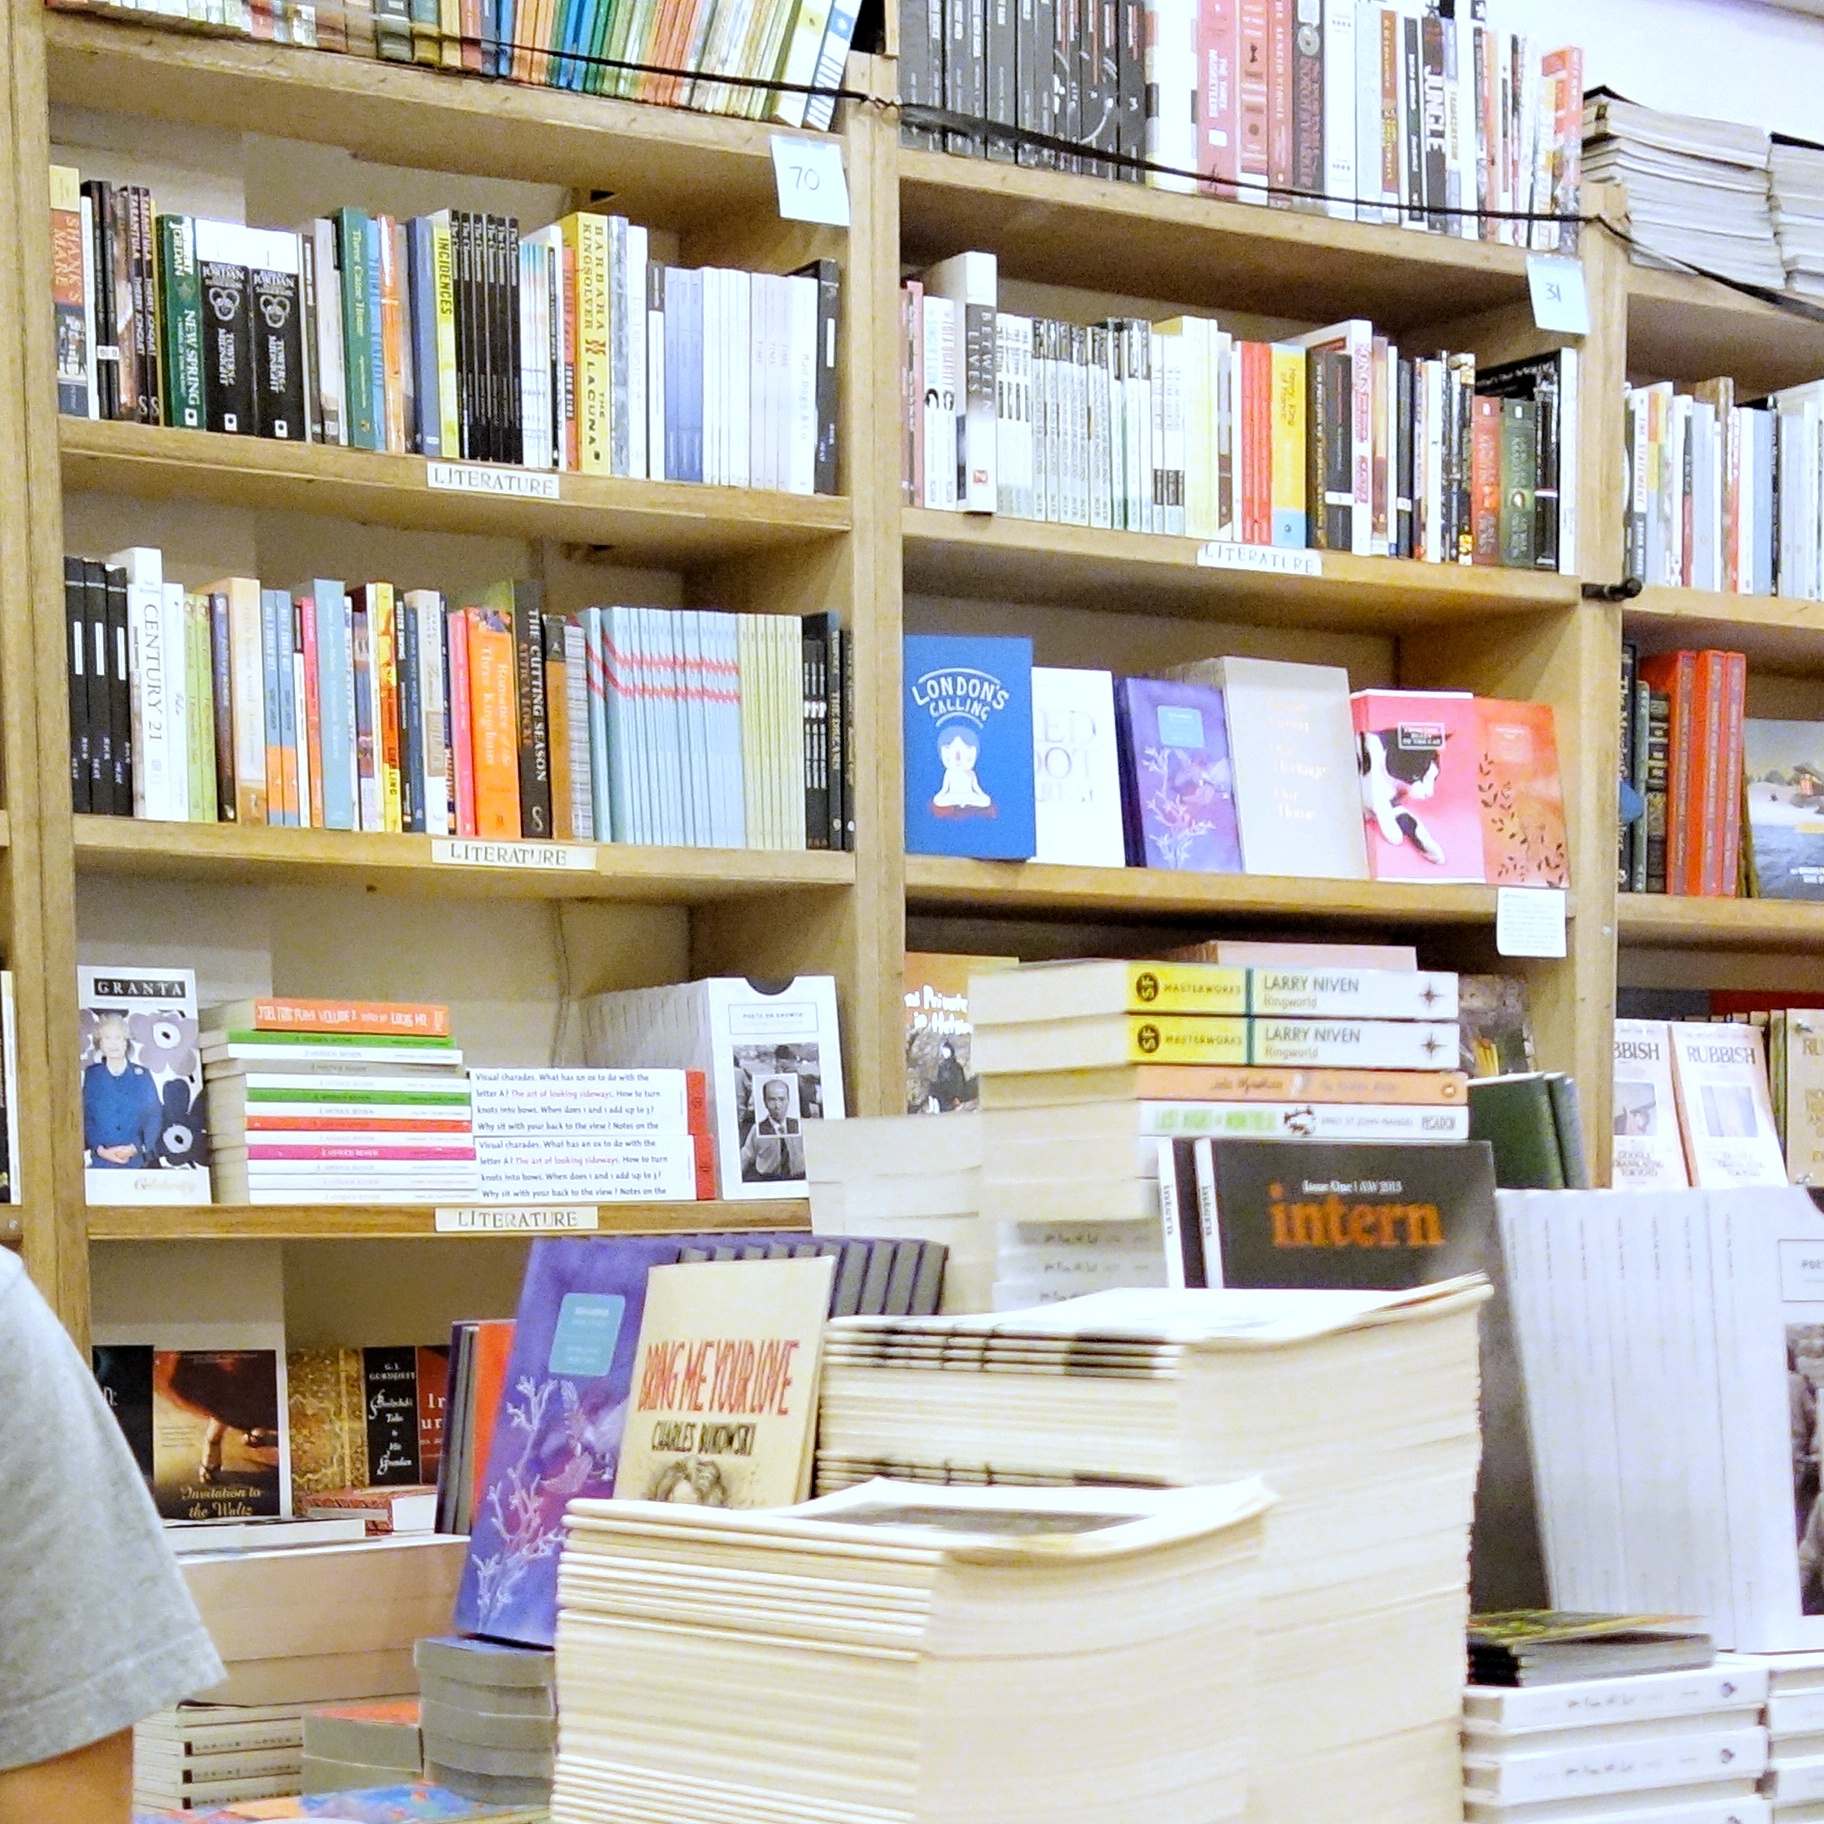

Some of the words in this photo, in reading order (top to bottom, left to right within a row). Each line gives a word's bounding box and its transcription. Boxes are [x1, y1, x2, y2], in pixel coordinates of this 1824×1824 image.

[1423, 65, 1446, 153] JUNGLE
[788, 165, 821, 193] 70
[168, 221, 185, 277] JORDAN
[437, 236, 454, 316] INCIDENCES
[583, 222, 595, 331] KINGSOLVER
[594, 223, 607, 331] BARBARA
[183, 309, 197, 347] NEW
[186, 348, 201, 406] SPRING
[968, 331, 981, 394] LIVES
[980, 311, 995, 417] BETWEEN
[586, 360, 598, 446] LACUNA
[598, 391, 606, 418] THE
[433, 466, 554, 496] LITERATURE
[1202, 546, 1314, 576] LITERATURE
[527, 607, 541, 640] THE
[143, 603, 163, 714] CENTURY
[480, 646, 493, 687] Three
[497, 663, 511, 730] Romance
[530, 644, 545, 717] CUTTING
[911, 675, 1011, 713] LONDON'S
[929, 697, 992, 723] CALLING
[148, 720, 164, 742] 21
[482, 692, 497, 766] Kingdoms
[533, 721, 547, 783] SEASON
[449, 843, 567, 868] LITERATURE
[96, 980, 185, 997] GRANTA
[1162, 982, 1243, 995] MASTERWORKS
[1264, 974, 1309, 992] LARRY
[1312, 976, 1360, 992] NIVEN
[1264, 994, 1317, 1010] Ringworld
[1163, 1033, 1243, 1047] MASTERWORKS
[1264, 1026, 1311, 1043] LARRY
[1313, 1028, 1361, 1044] NIVEN
[1265, 1044, 1318, 1060] Ringworld
[1686, 1043, 1757, 1064] RUBBISH
[457, 1208, 578, 1229] LITERATURE
[1268, 1179, 1445, 1248] intern
[179, 1485, 246, 1502] Invitation
[249, 1487, 263, 1500] to
[187, 1502, 210, 1520] the
[212, 1501, 254, 1520] Waltz
